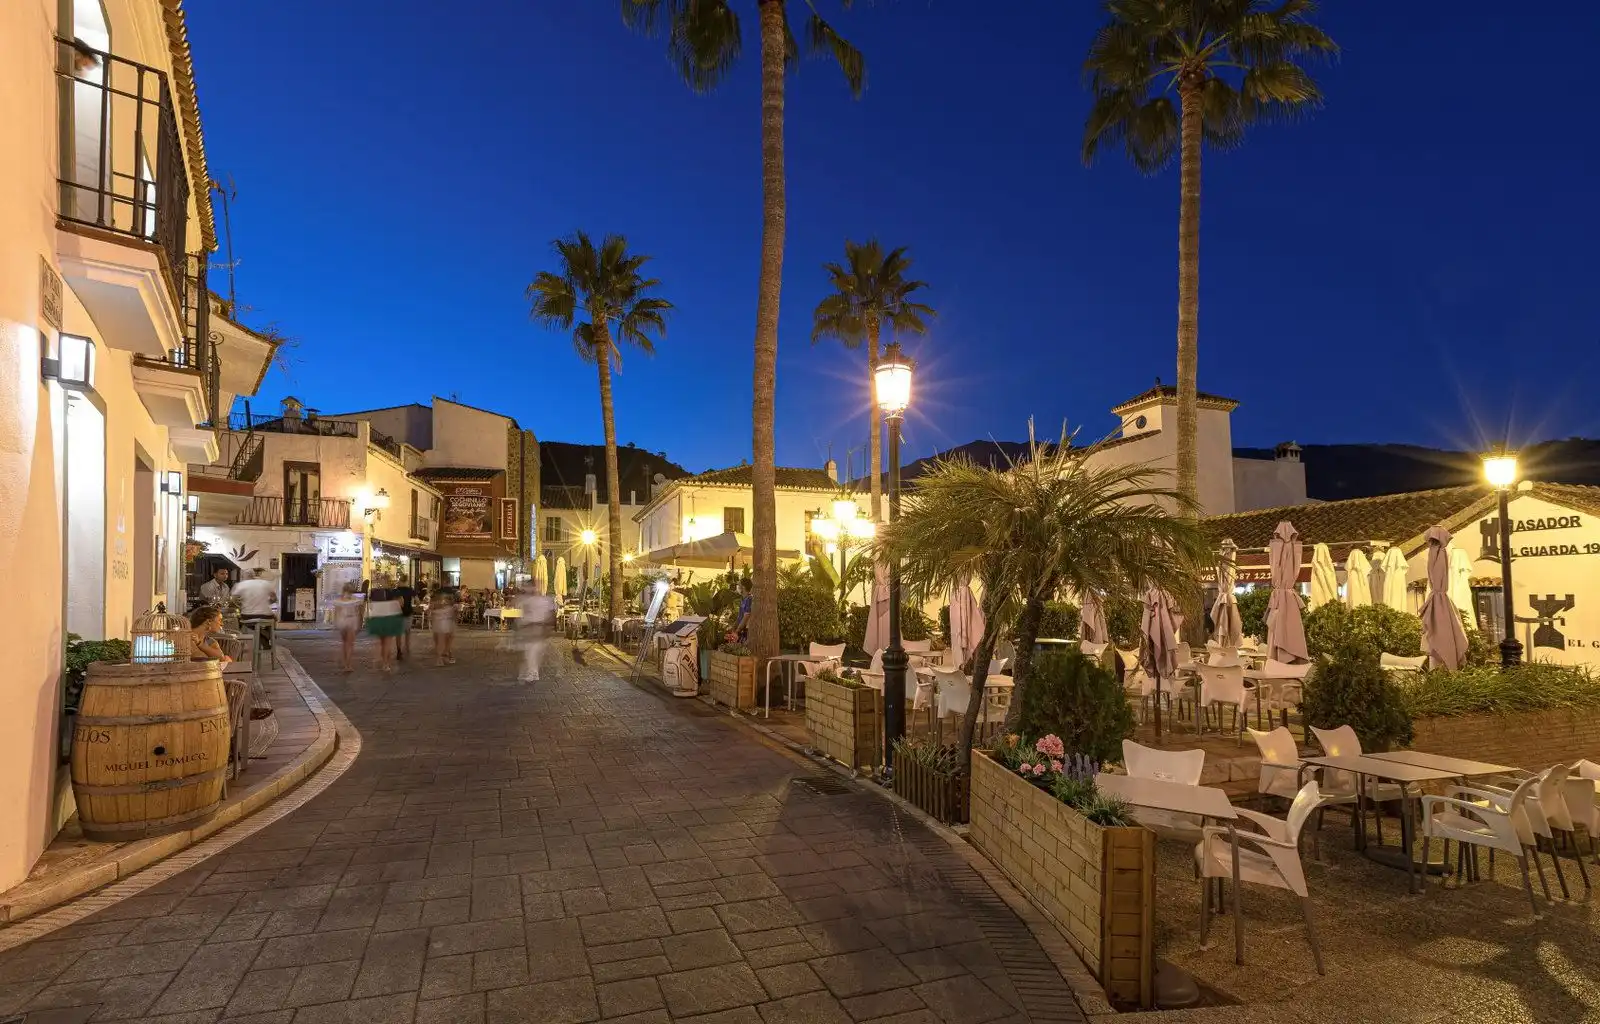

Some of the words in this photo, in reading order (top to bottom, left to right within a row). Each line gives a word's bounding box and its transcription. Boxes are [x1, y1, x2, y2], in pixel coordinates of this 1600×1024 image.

[1516, 515, 1582, 531] ASADOR
[1520, 544, 1580, 557] GUARDA
[1568, 638, 1585, 648] EL
[104, 761, 152, 773] MIGUEL
